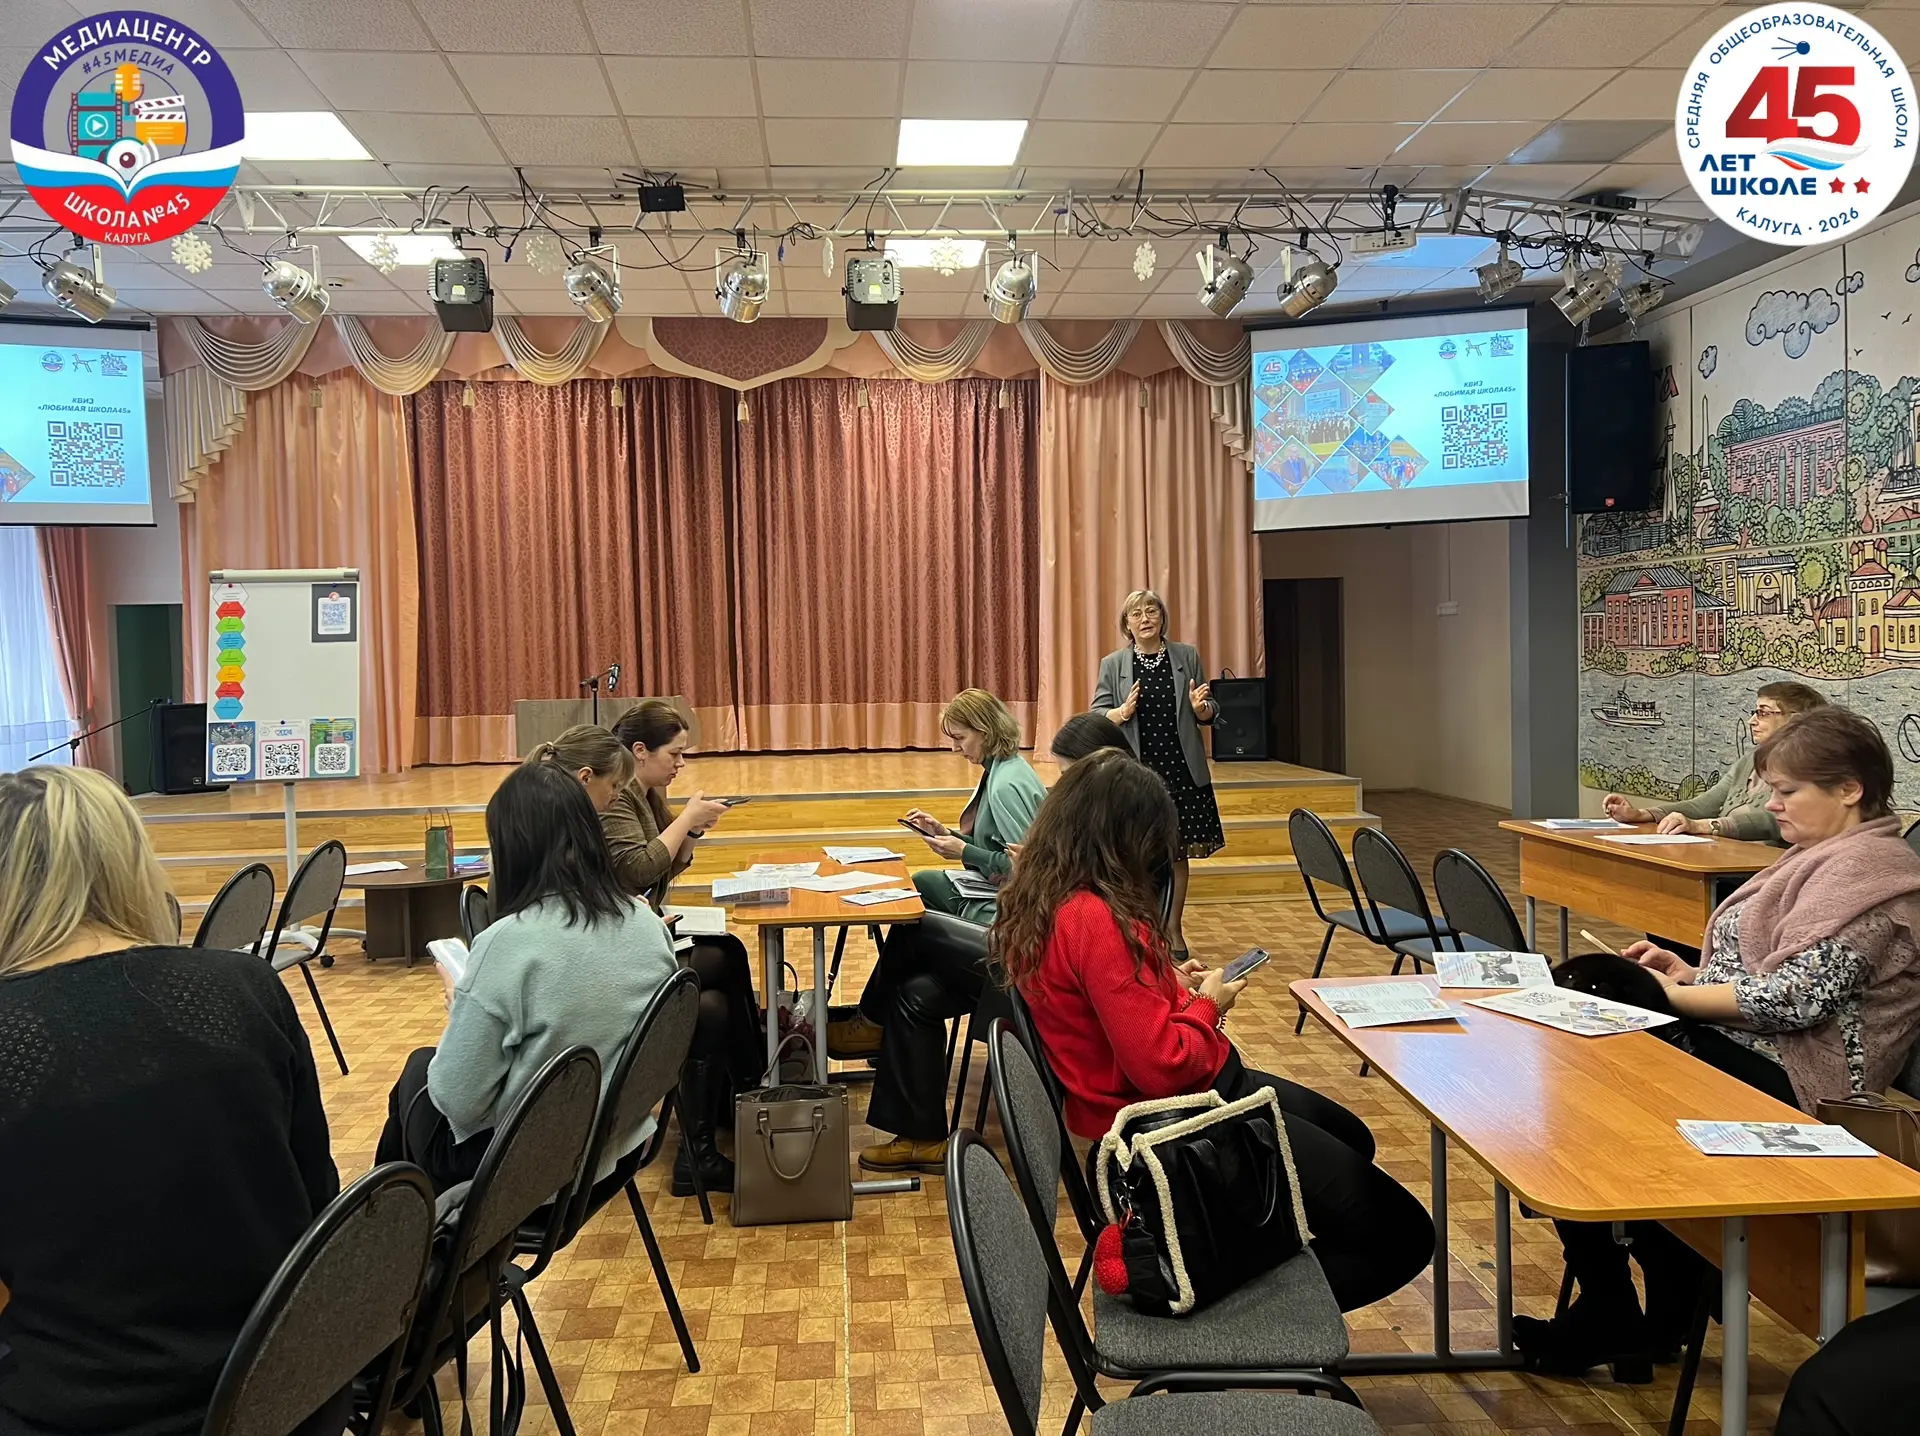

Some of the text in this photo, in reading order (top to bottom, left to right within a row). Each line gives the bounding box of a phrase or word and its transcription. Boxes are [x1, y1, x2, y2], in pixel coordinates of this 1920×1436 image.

[1463, 380, 1483, 388] КВИЗ
[1433, 389, 1476, 398] «ЛЮБИМАЯ
[71, 397, 94, 405] КВИЗ
[37, 404, 131, 414] «ЛЮБИМАЯ ШКОЛА45»
